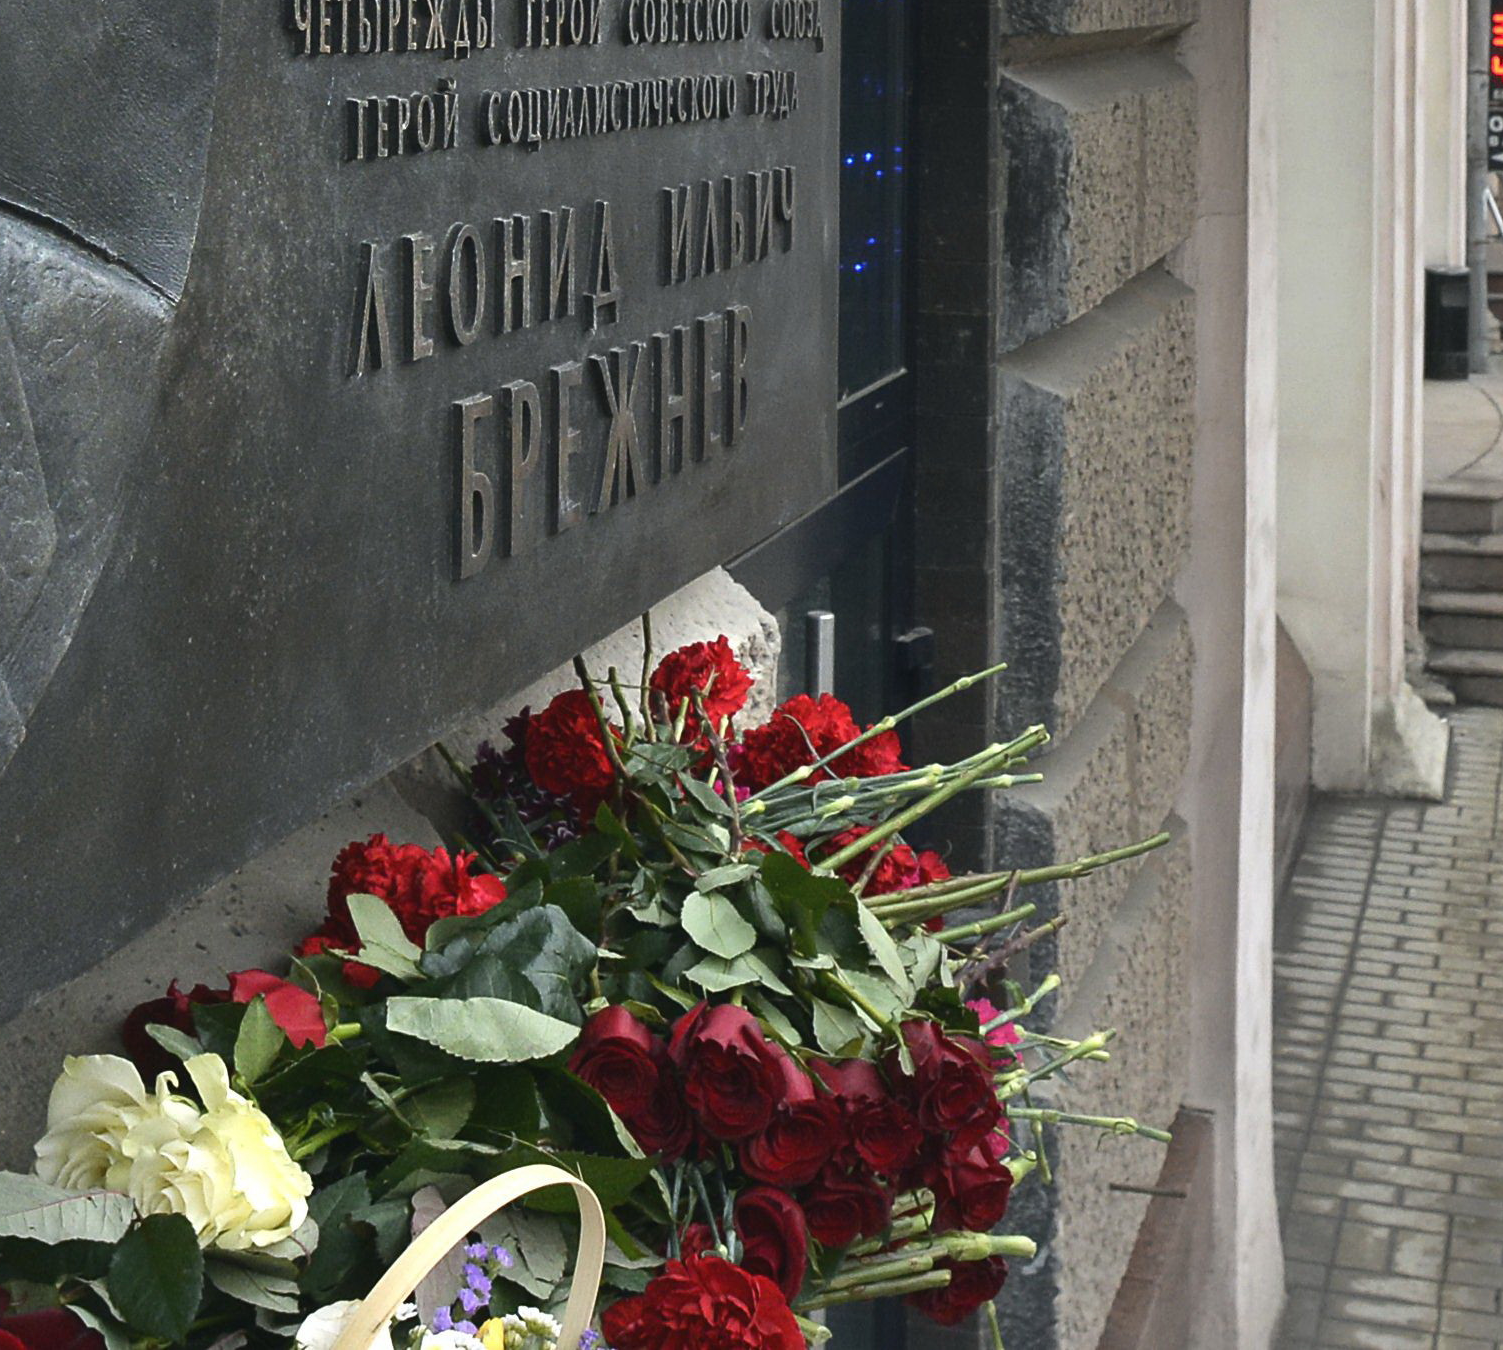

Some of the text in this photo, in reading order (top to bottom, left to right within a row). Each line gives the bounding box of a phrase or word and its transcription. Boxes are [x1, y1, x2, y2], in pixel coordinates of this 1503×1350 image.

[350, 69, 798, 160] ГЕРОЙ СОЦИАЛИСТИЧЕСКОГО ТРУДА
[1489, 135, 1499, 147] В
[355, 165, 796, 377] ЛЕОНИД ИЛЬИЧ
[453, 304, 753, 580] БРЕЖНЕВ
